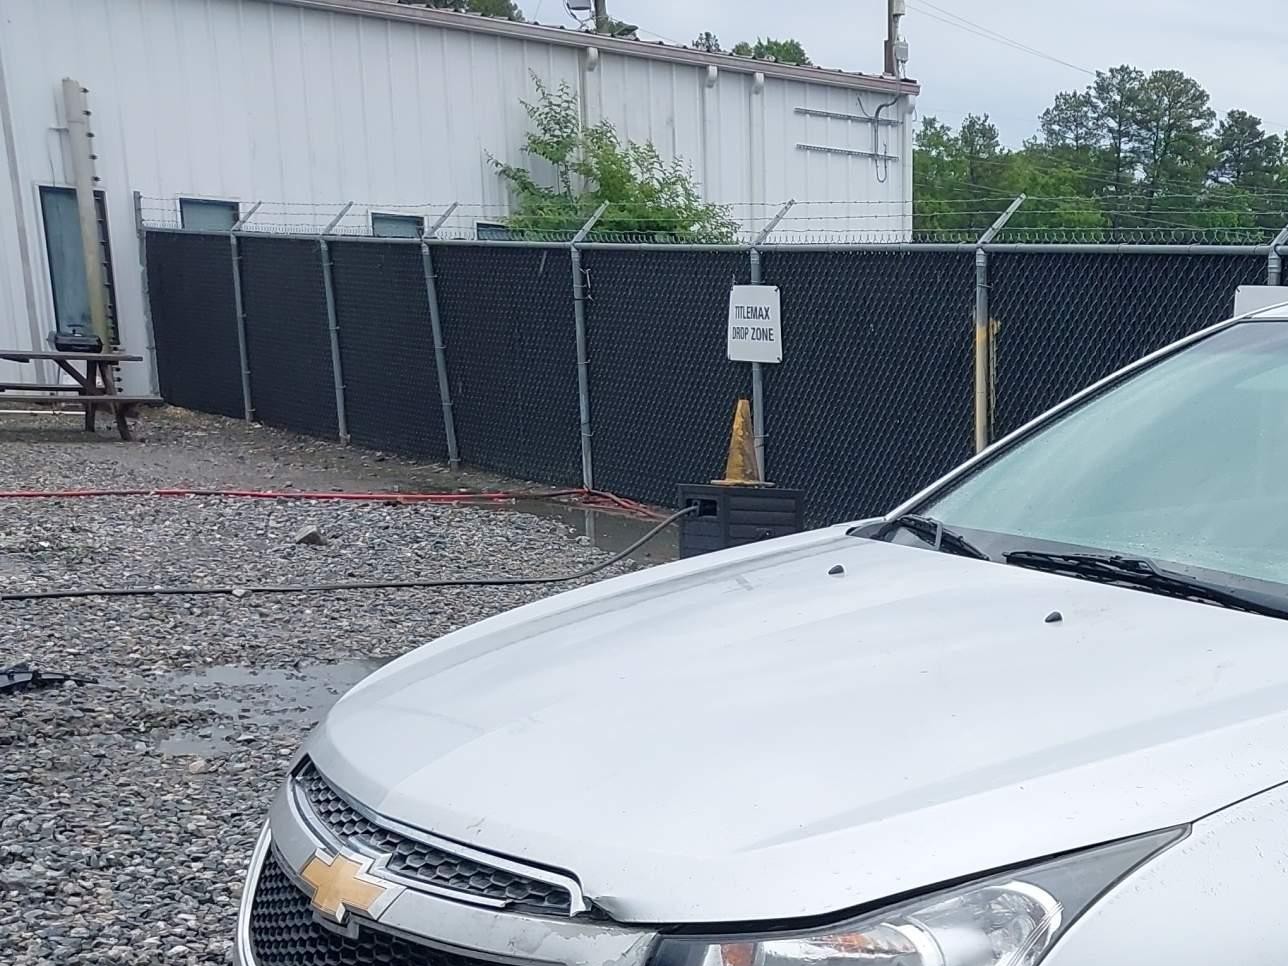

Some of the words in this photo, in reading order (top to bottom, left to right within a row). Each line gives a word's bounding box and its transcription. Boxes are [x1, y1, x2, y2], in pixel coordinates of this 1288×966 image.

[735, 305, 770, 320] TITLEMAX
[732, 326, 749, 340] DROP
[751, 327, 775, 341] ZONE
